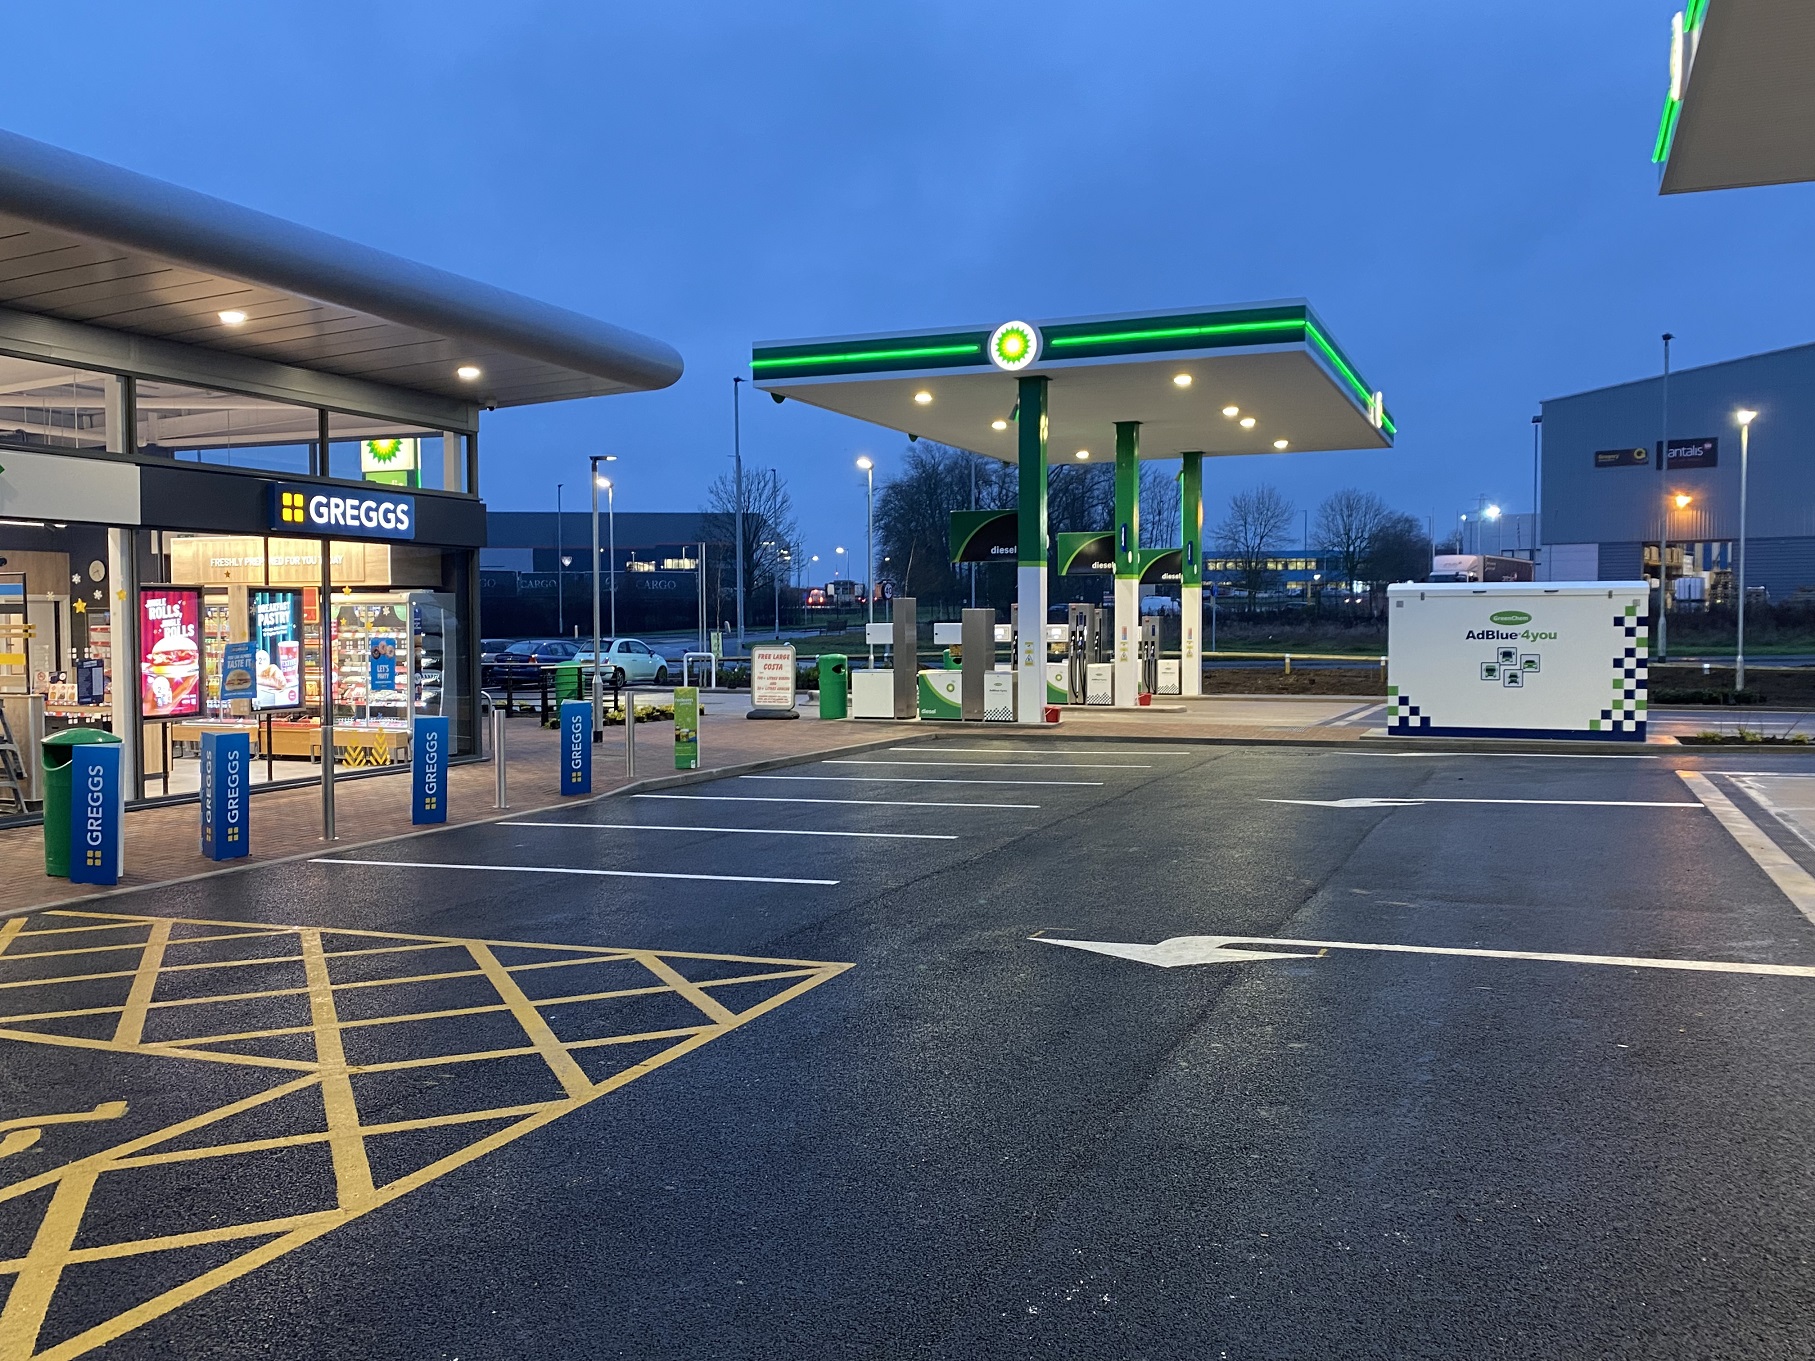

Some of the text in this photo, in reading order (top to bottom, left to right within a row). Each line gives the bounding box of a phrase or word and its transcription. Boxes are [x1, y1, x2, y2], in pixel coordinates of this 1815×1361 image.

[1667, 445, 1704, 458] antalis
[309, 495, 410, 530] GREGGS
[990, 545, 1017, 554] diesel
[210, 557, 244, 567] FRESHLY
[244, 556, 284, 566] PREPRED
[285, 556, 301, 566] FOR
[301, 555, 317, 565] YOU
[1091, 561, 1115, 569] diesel
[520, 579, 557, 589] CARGO
[635, 579, 677, 590] CARGO
[148, 604, 182, 620] ROLLS,
[257, 611, 291, 626] PASTRY
[164, 624, 195, 639] ROLLS
[1465, 630, 1558, 642] AdBlue 4you
[227, 658, 244, 669] TASTE
[376, 664, 390, 673] LET'S
[763, 663, 783, 671] COSTA
[571, 715, 582, 769] GREGGS
[425, 731, 438, 794] GREGGS
[227, 750, 240, 824] GREGGS
[86, 765, 104, 846] GREGGS
